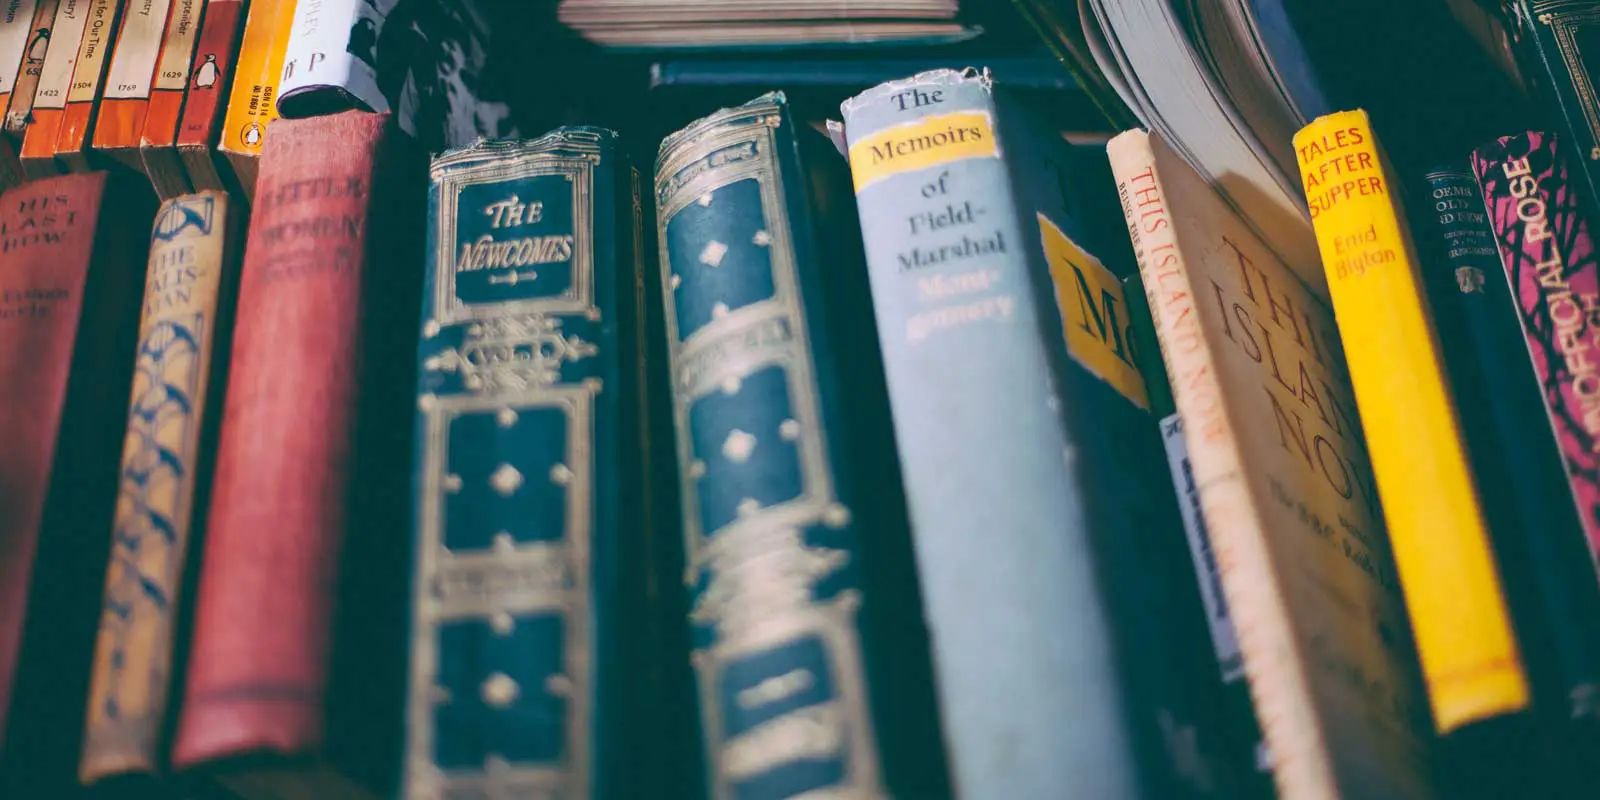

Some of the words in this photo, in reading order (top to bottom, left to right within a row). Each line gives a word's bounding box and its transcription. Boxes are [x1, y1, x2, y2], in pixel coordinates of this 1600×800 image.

[91, 20, 104, 36] Our
[85, 38, 100, 59] Time
[73, 82, 92, 90] 1504
[118, 84, 137, 92] 1769
[162, 71, 182, 79] 1629
[39, 89, 59, 97] 1422
[263, 86, 273, 101] ISBN
[890, 87, 945, 112] The
[870, 125, 983, 166] Memoirs
[1299, 127, 1364, 165] TALES
[920, 170, 951, 199] of
[1306, 151, 1375, 193] AFTER
[19, 194, 68, 212] HIS
[485, 195, 544, 228] THE
[1119, 182, 1134, 218] BEING
[1308, 176, 1385, 219] SUPPER
[1502, 156, 1553, 244] ROSE
[907, 202, 988, 236] Field-
[456, 234, 574, 272] NEWCOMES
[896, 232, 1007, 272] Marshal
[1332, 224, 1378, 255] Enid
[1131, 166, 1168, 234] THIS
[1151, 243, 1202, 352] ISLAND
[1335, 247, 1397, 281] Blyton
